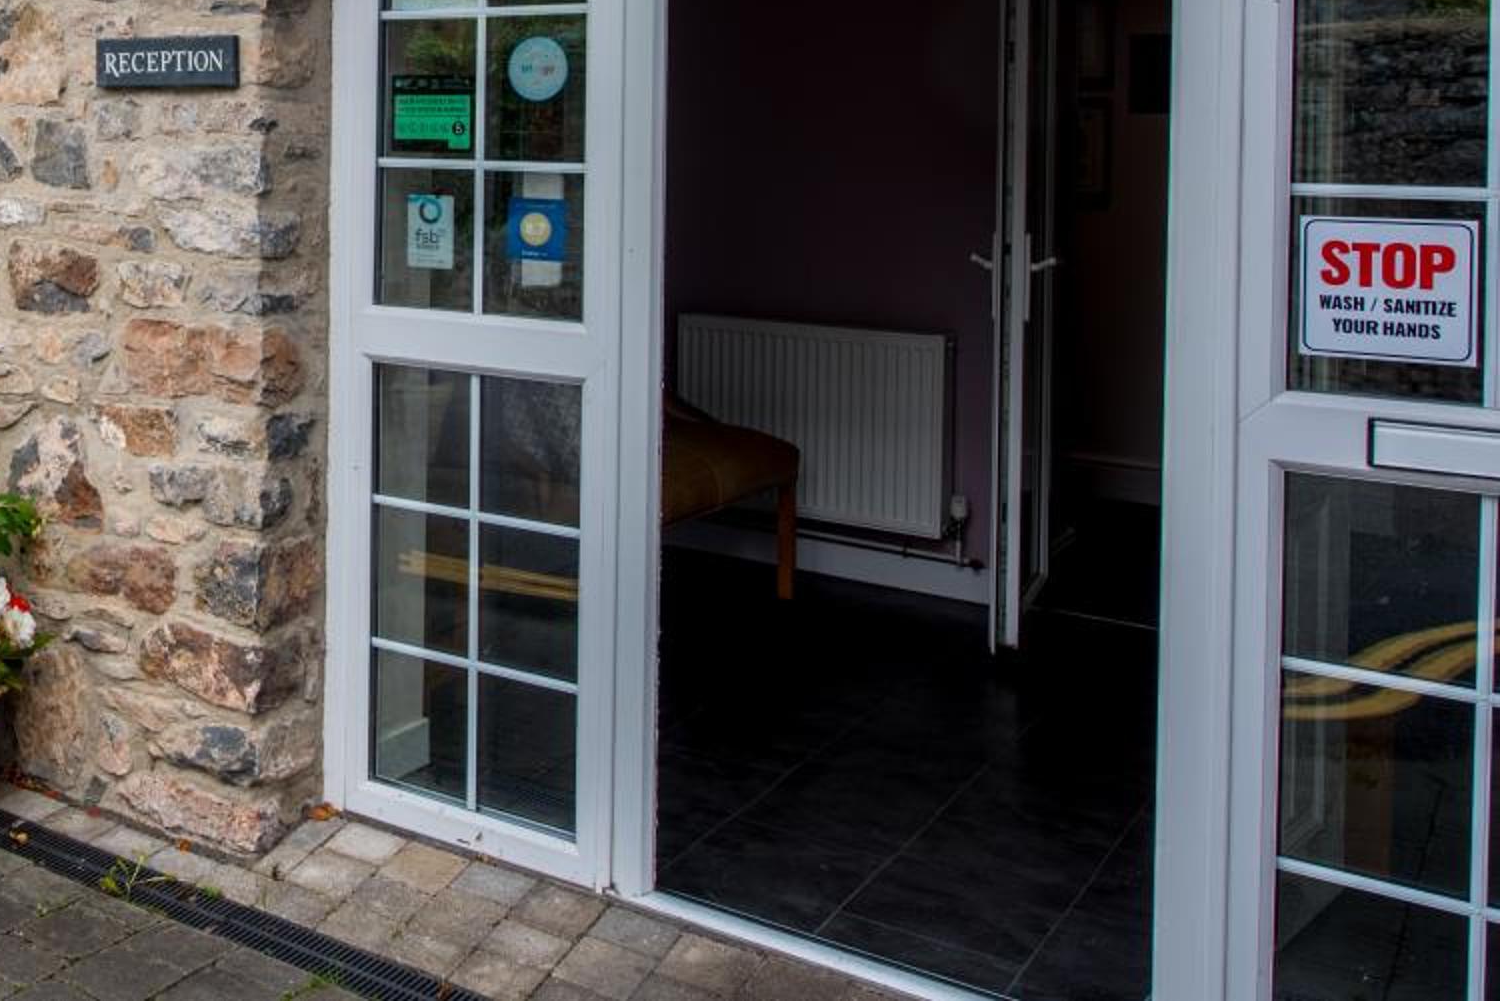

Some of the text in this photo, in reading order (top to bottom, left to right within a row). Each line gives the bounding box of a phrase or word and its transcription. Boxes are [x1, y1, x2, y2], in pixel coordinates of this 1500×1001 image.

[104, 50, 224, 78] RECEPTION
[1320, 240, 1456, 290] STOP
[1319, 294, 1365, 311] WASH
[1383, 298, 1457, 318] SANITIZE
[1332, 318, 1441, 340] YOUR HANDS
